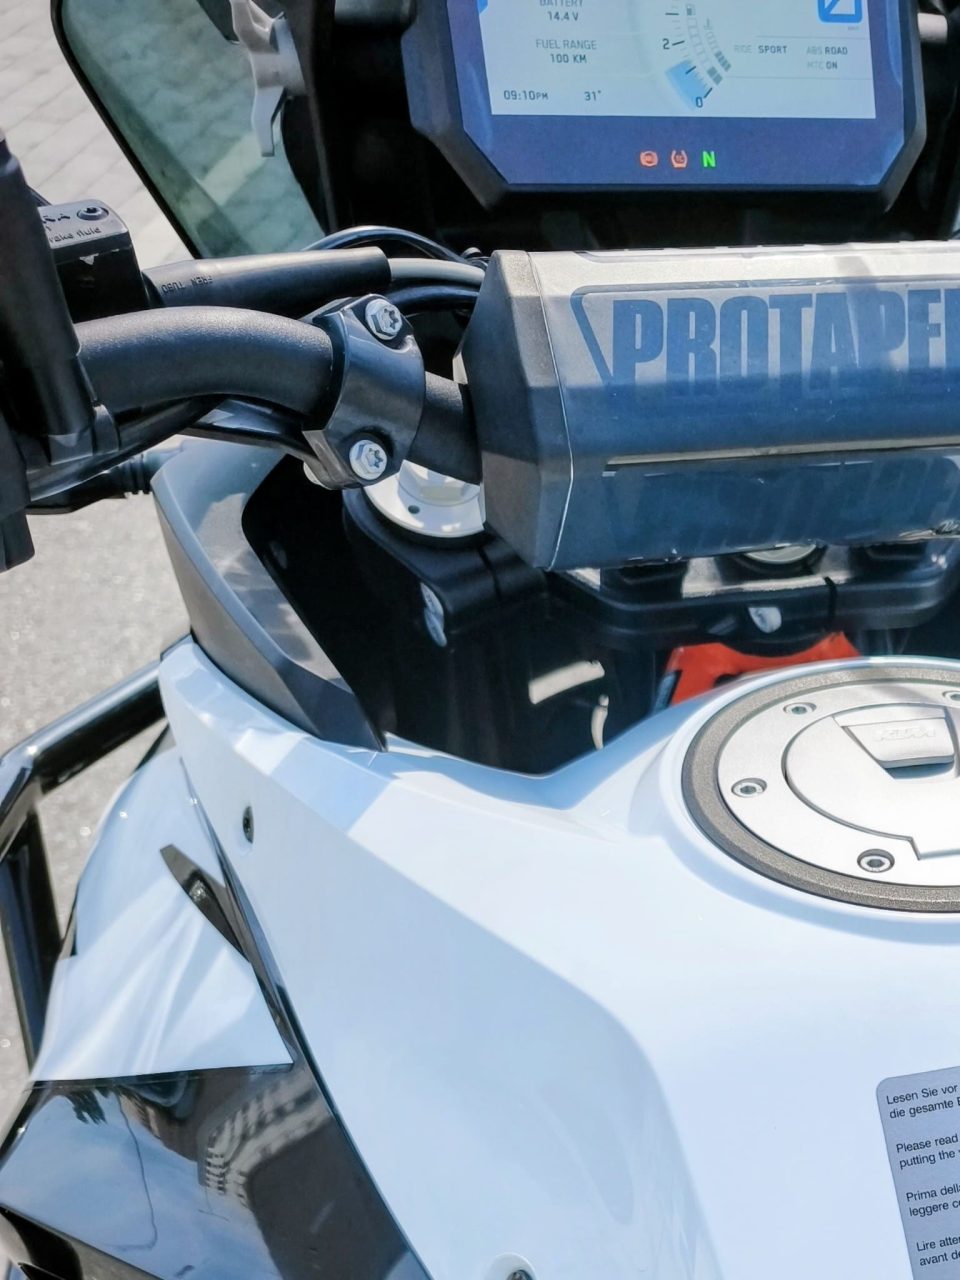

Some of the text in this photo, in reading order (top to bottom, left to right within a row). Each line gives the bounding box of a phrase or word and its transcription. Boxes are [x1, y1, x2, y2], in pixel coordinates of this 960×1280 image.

[548, 11, 579, 21] 14.4 V
[536, 39, 597, 50] FUEL RANGE
[662, 38, 670, 50] 2
[758, 45, 788, 54] SPORT
[824, 46, 848, 55] ROAD
[550, 53, 587, 63] 100 KM
[826, 61, 838, 70] ON
[695, 96, 703, 108] 0
[702, 151, 716, 167] N
[886, 1092, 918, 1105] Lesen
[921, 1088, 938, 1098] Sie
[941, 1085, 958, 1095] vor
[889, 1109, 906, 1119] die
[909, 1100, 954, 1117] gesamte
[896, 1140, 931, 1153] Please
[935, 1133, 958, 1146] read
[899, 1154, 936, 1170] putting
[938, 1150, 955, 1160] the
[906, 1189, 937, 1202] Prima
[909, 1202, 949, 1217] leggere
[916, 1240, 936, 1252] Lire
[919, 1253, 948, 1266] avant
